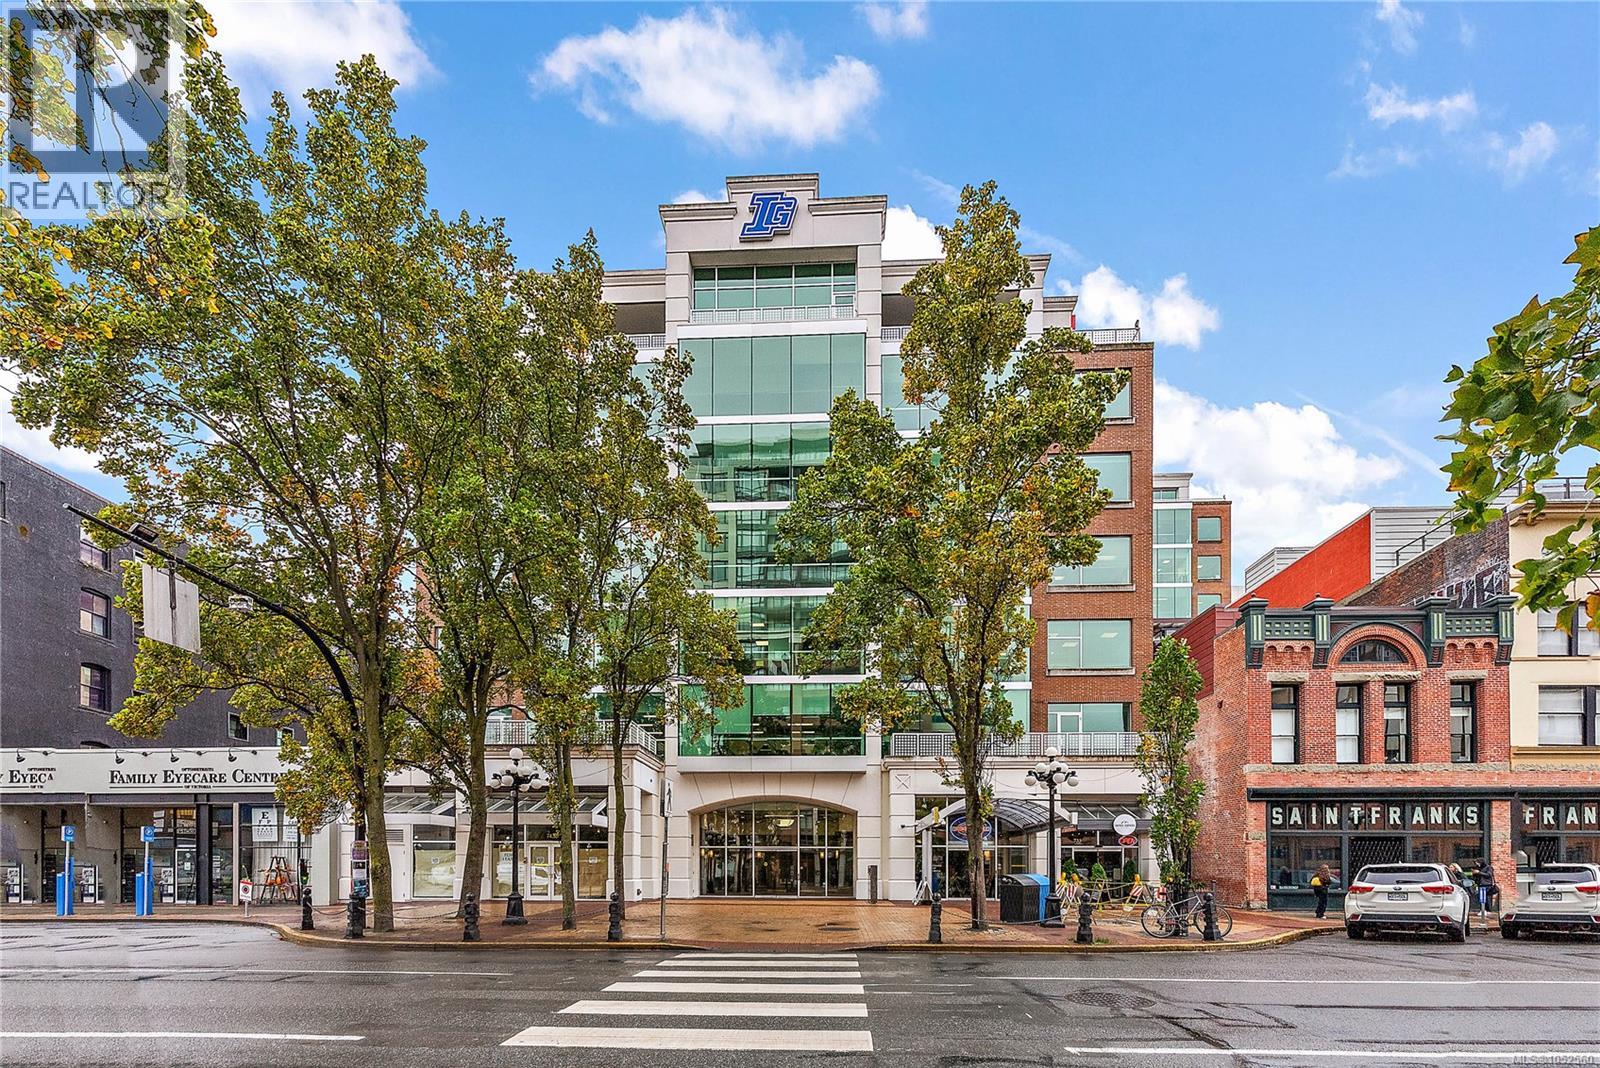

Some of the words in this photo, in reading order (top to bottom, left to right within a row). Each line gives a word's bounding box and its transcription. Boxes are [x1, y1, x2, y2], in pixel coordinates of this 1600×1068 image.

[741, 192, 798, 238] IG
[109, 769, 158, 784] FAMILY
[162, 769, 227, 784] EYECARE
[261, 811, 269, 819] E
[1272, 806, 1361, 825] SAINT
[1371, 806, 1479, 825] FRANKS
[1525, 806, 1597, 825] FRAN
